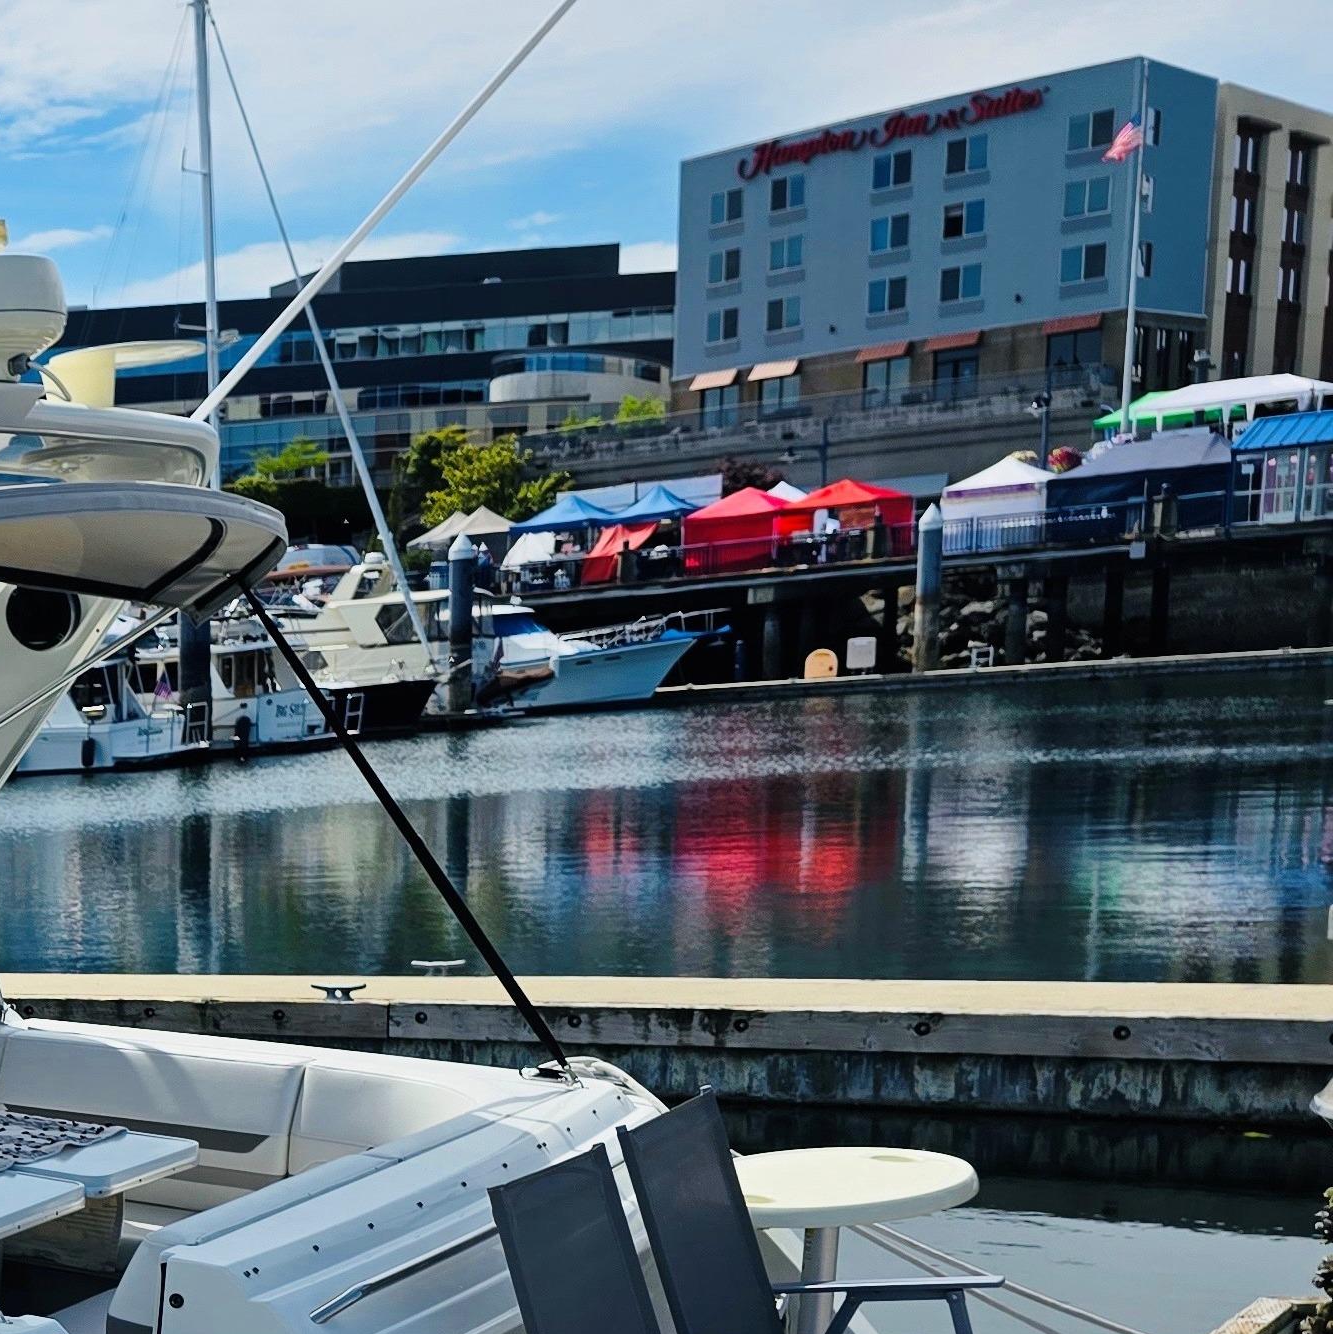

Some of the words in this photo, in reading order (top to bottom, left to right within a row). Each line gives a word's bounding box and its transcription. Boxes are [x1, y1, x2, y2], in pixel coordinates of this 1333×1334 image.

[738, 129, 868, 180] Hampton
[869, 110, 937, 148] Inn
[966, 86, 1045, 125] Suites
